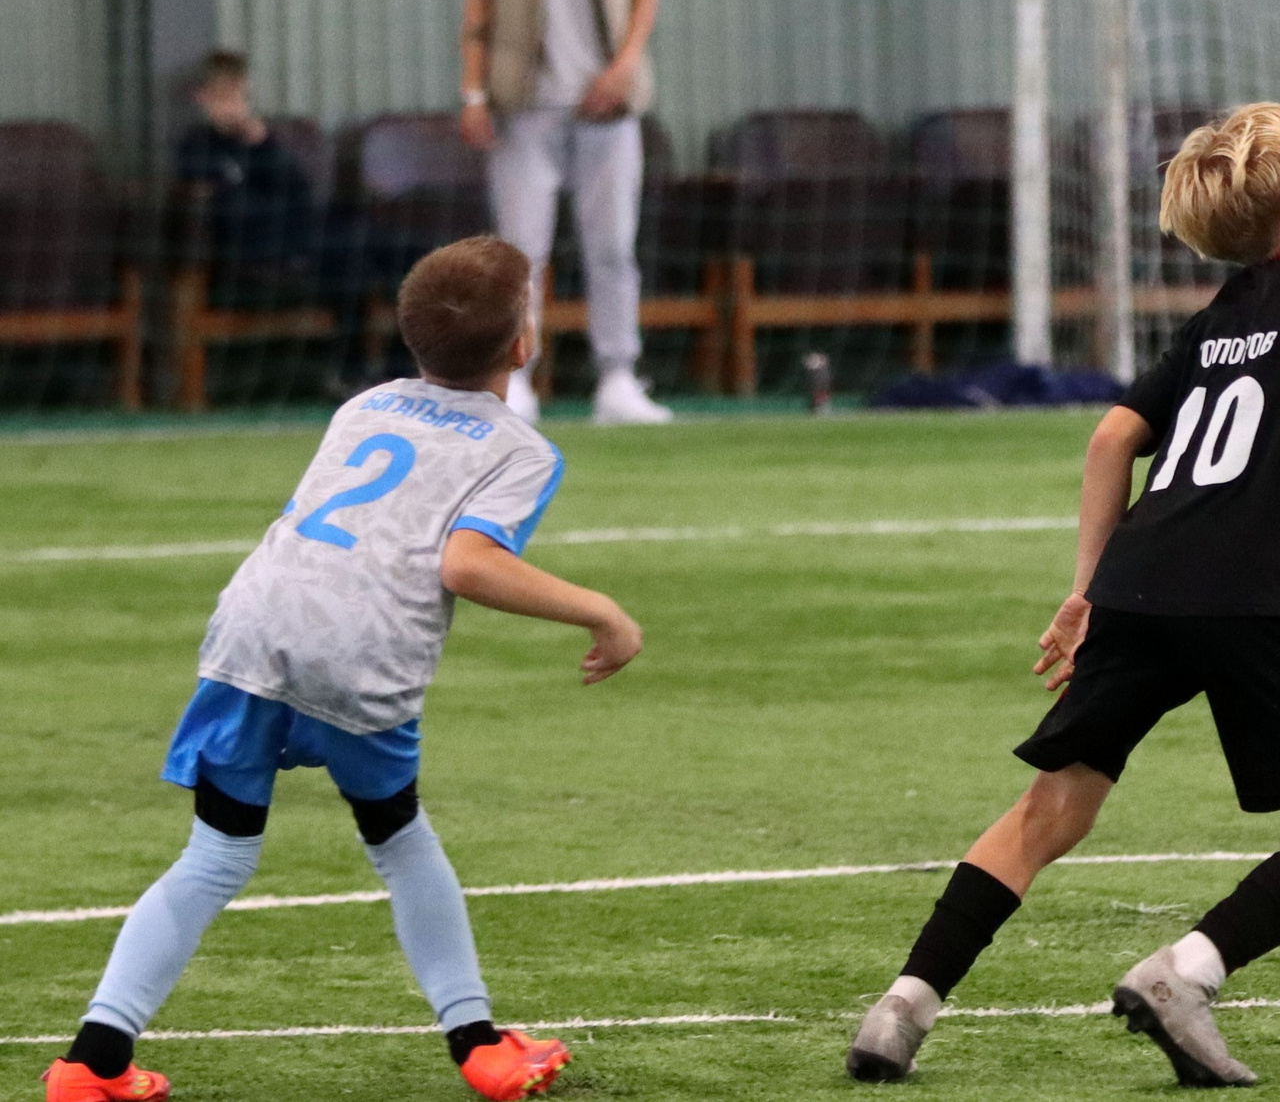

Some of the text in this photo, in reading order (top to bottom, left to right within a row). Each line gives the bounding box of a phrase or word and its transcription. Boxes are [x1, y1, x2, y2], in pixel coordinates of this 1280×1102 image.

[1200, 331, 1279, 369] ОПООВ
[295, 432, 417, 550] 2
[1149, 375, 1265, 492] 10
